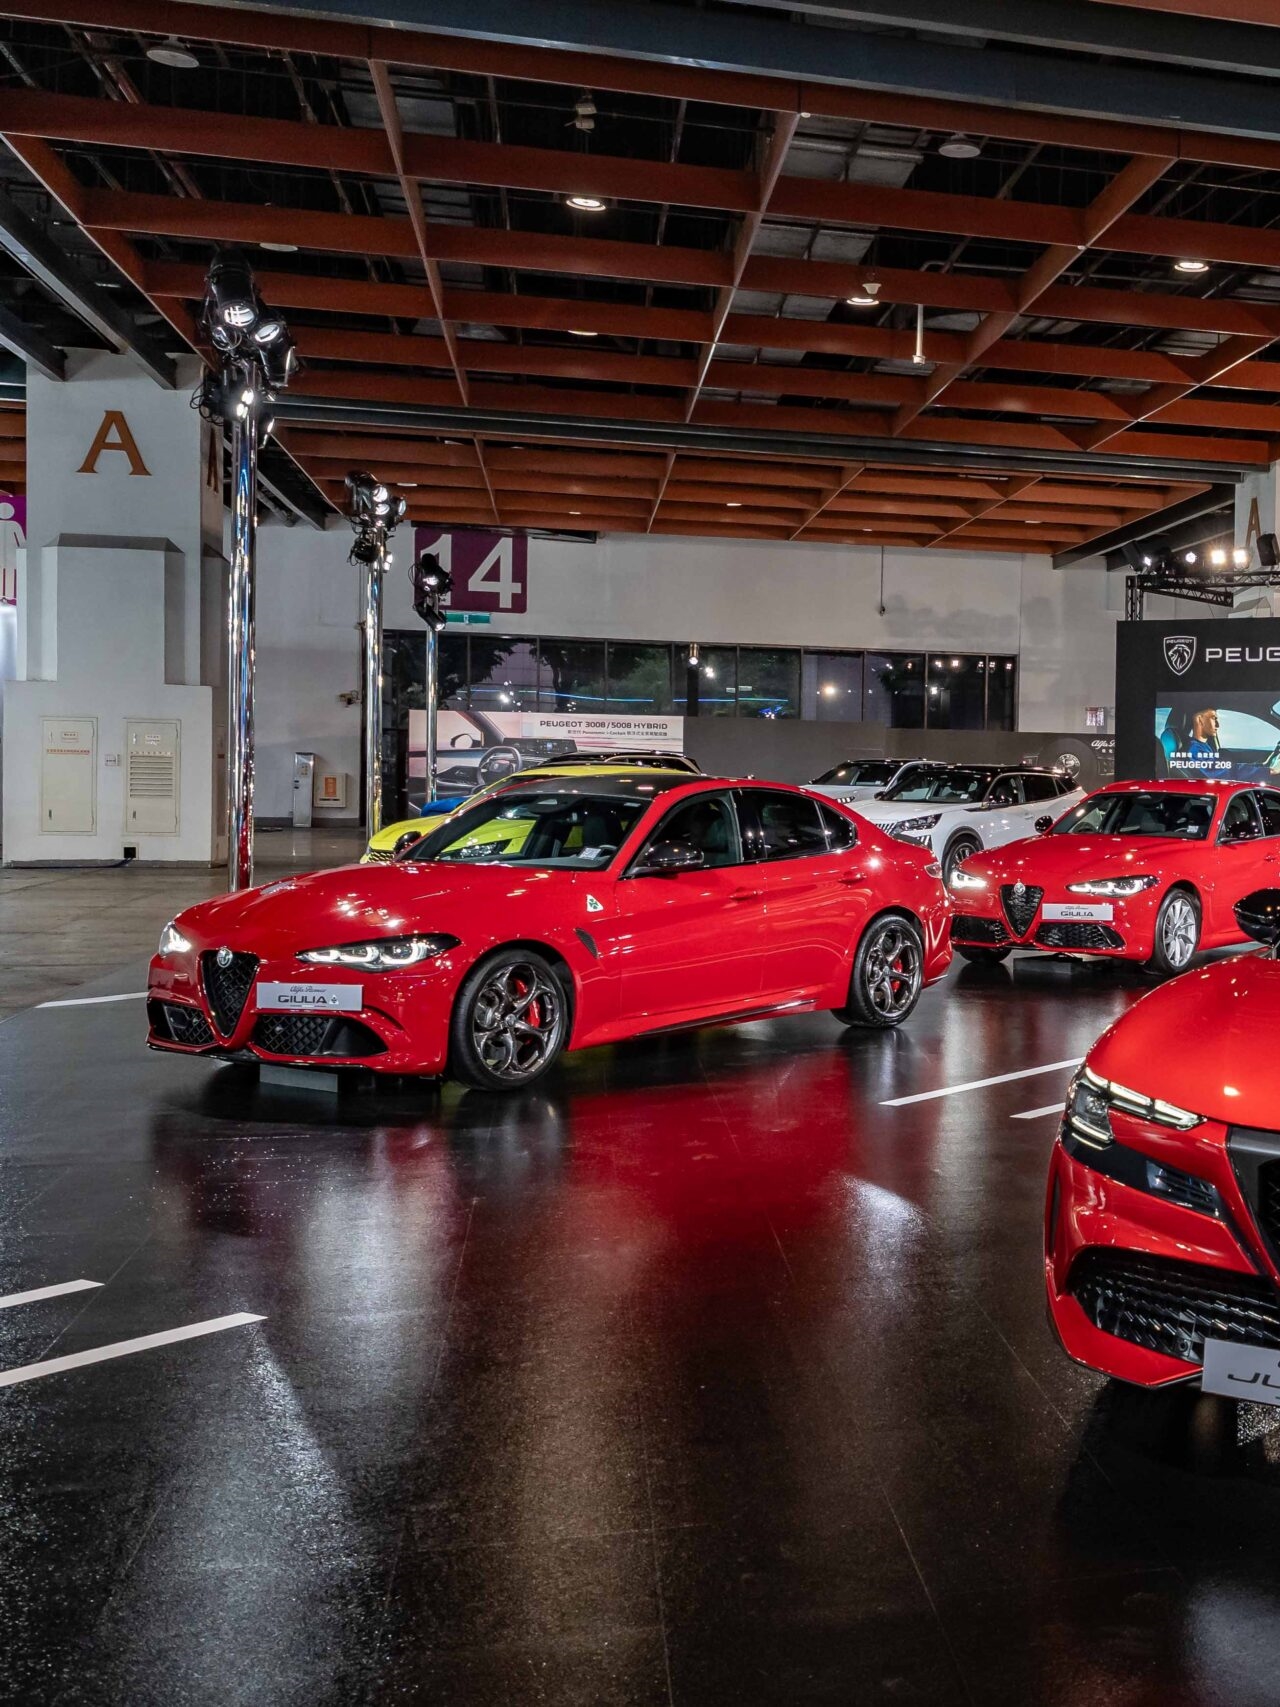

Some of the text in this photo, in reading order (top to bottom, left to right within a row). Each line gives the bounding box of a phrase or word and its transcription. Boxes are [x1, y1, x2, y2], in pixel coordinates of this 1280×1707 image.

[75, 410, 152, 476] A
[420, 533, 522, 609] 14
[539, 720, 583, 728] PEUGEOT
[1169, 760, 1232, 769] PEUGEOT 208
[277, 994, 328, 1004] GIULIA
